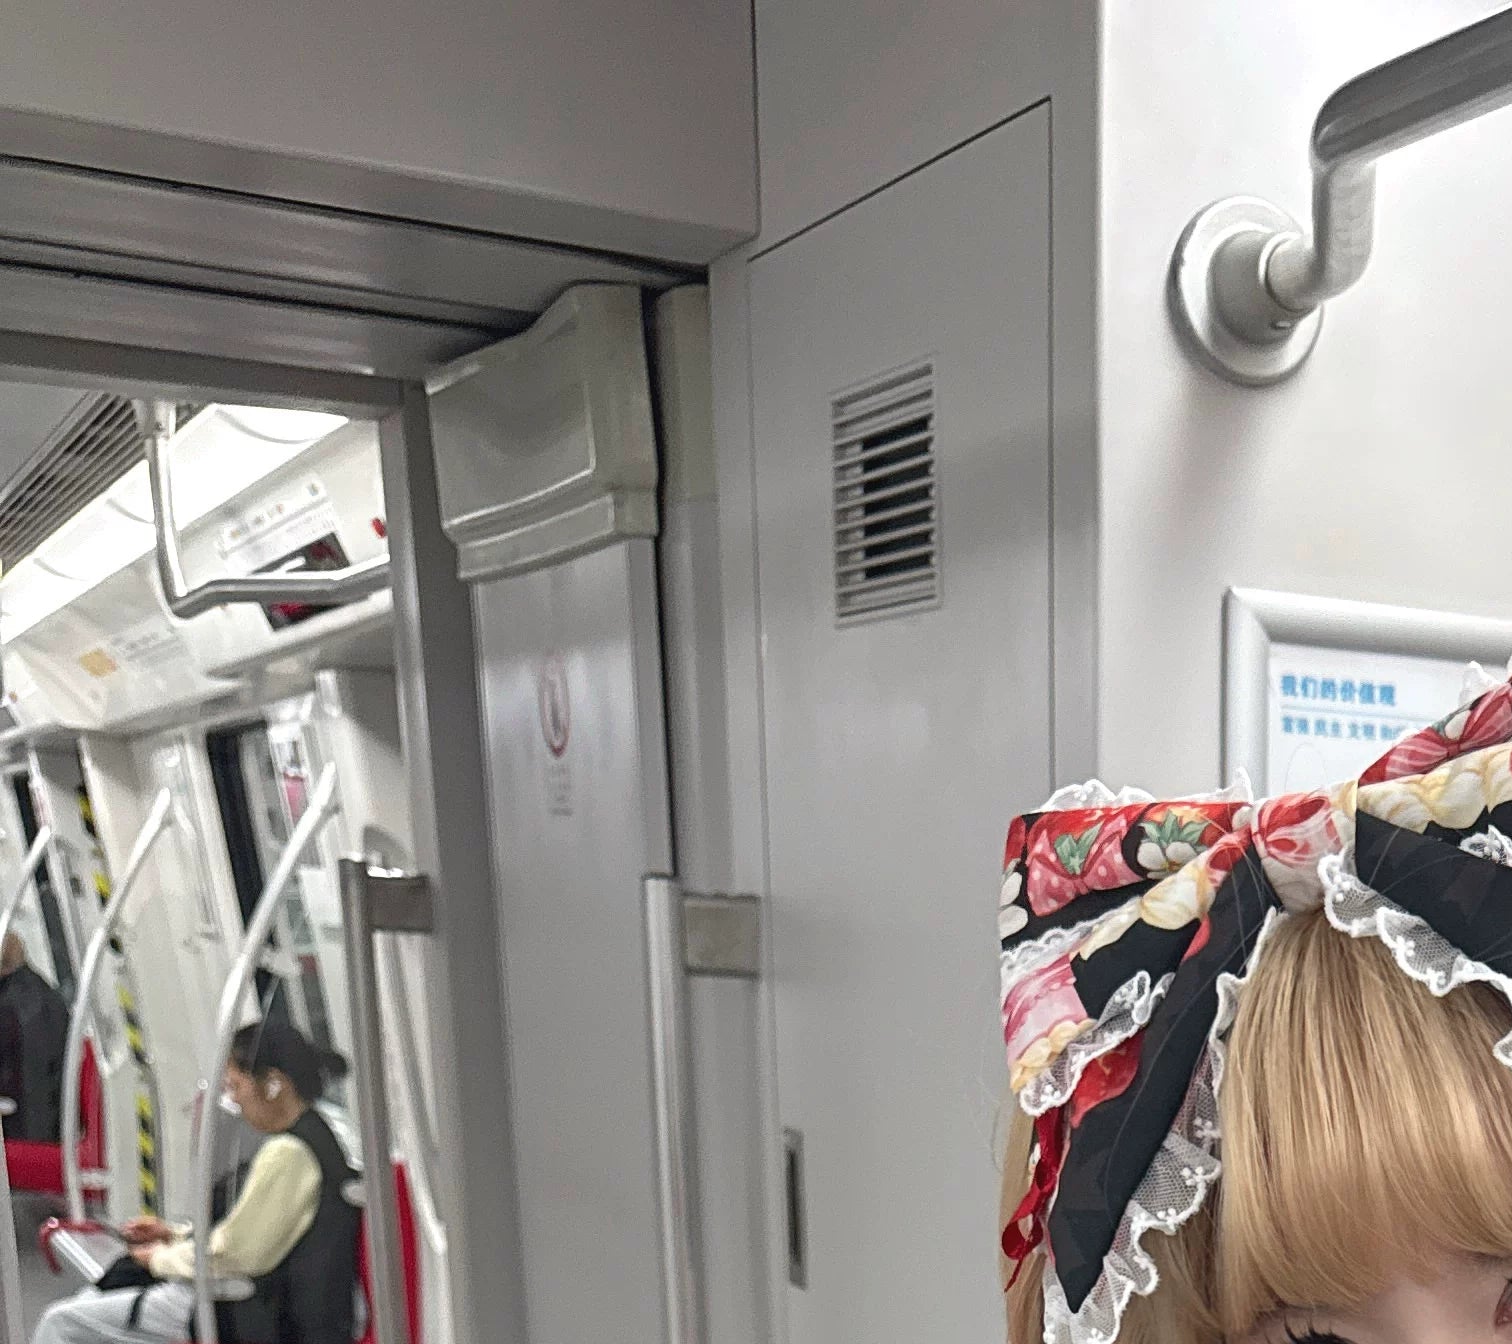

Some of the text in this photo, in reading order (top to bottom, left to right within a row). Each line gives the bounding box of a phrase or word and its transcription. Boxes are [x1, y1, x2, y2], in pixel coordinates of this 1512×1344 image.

[1281, 674, 1396, 707] 我们的价值观
